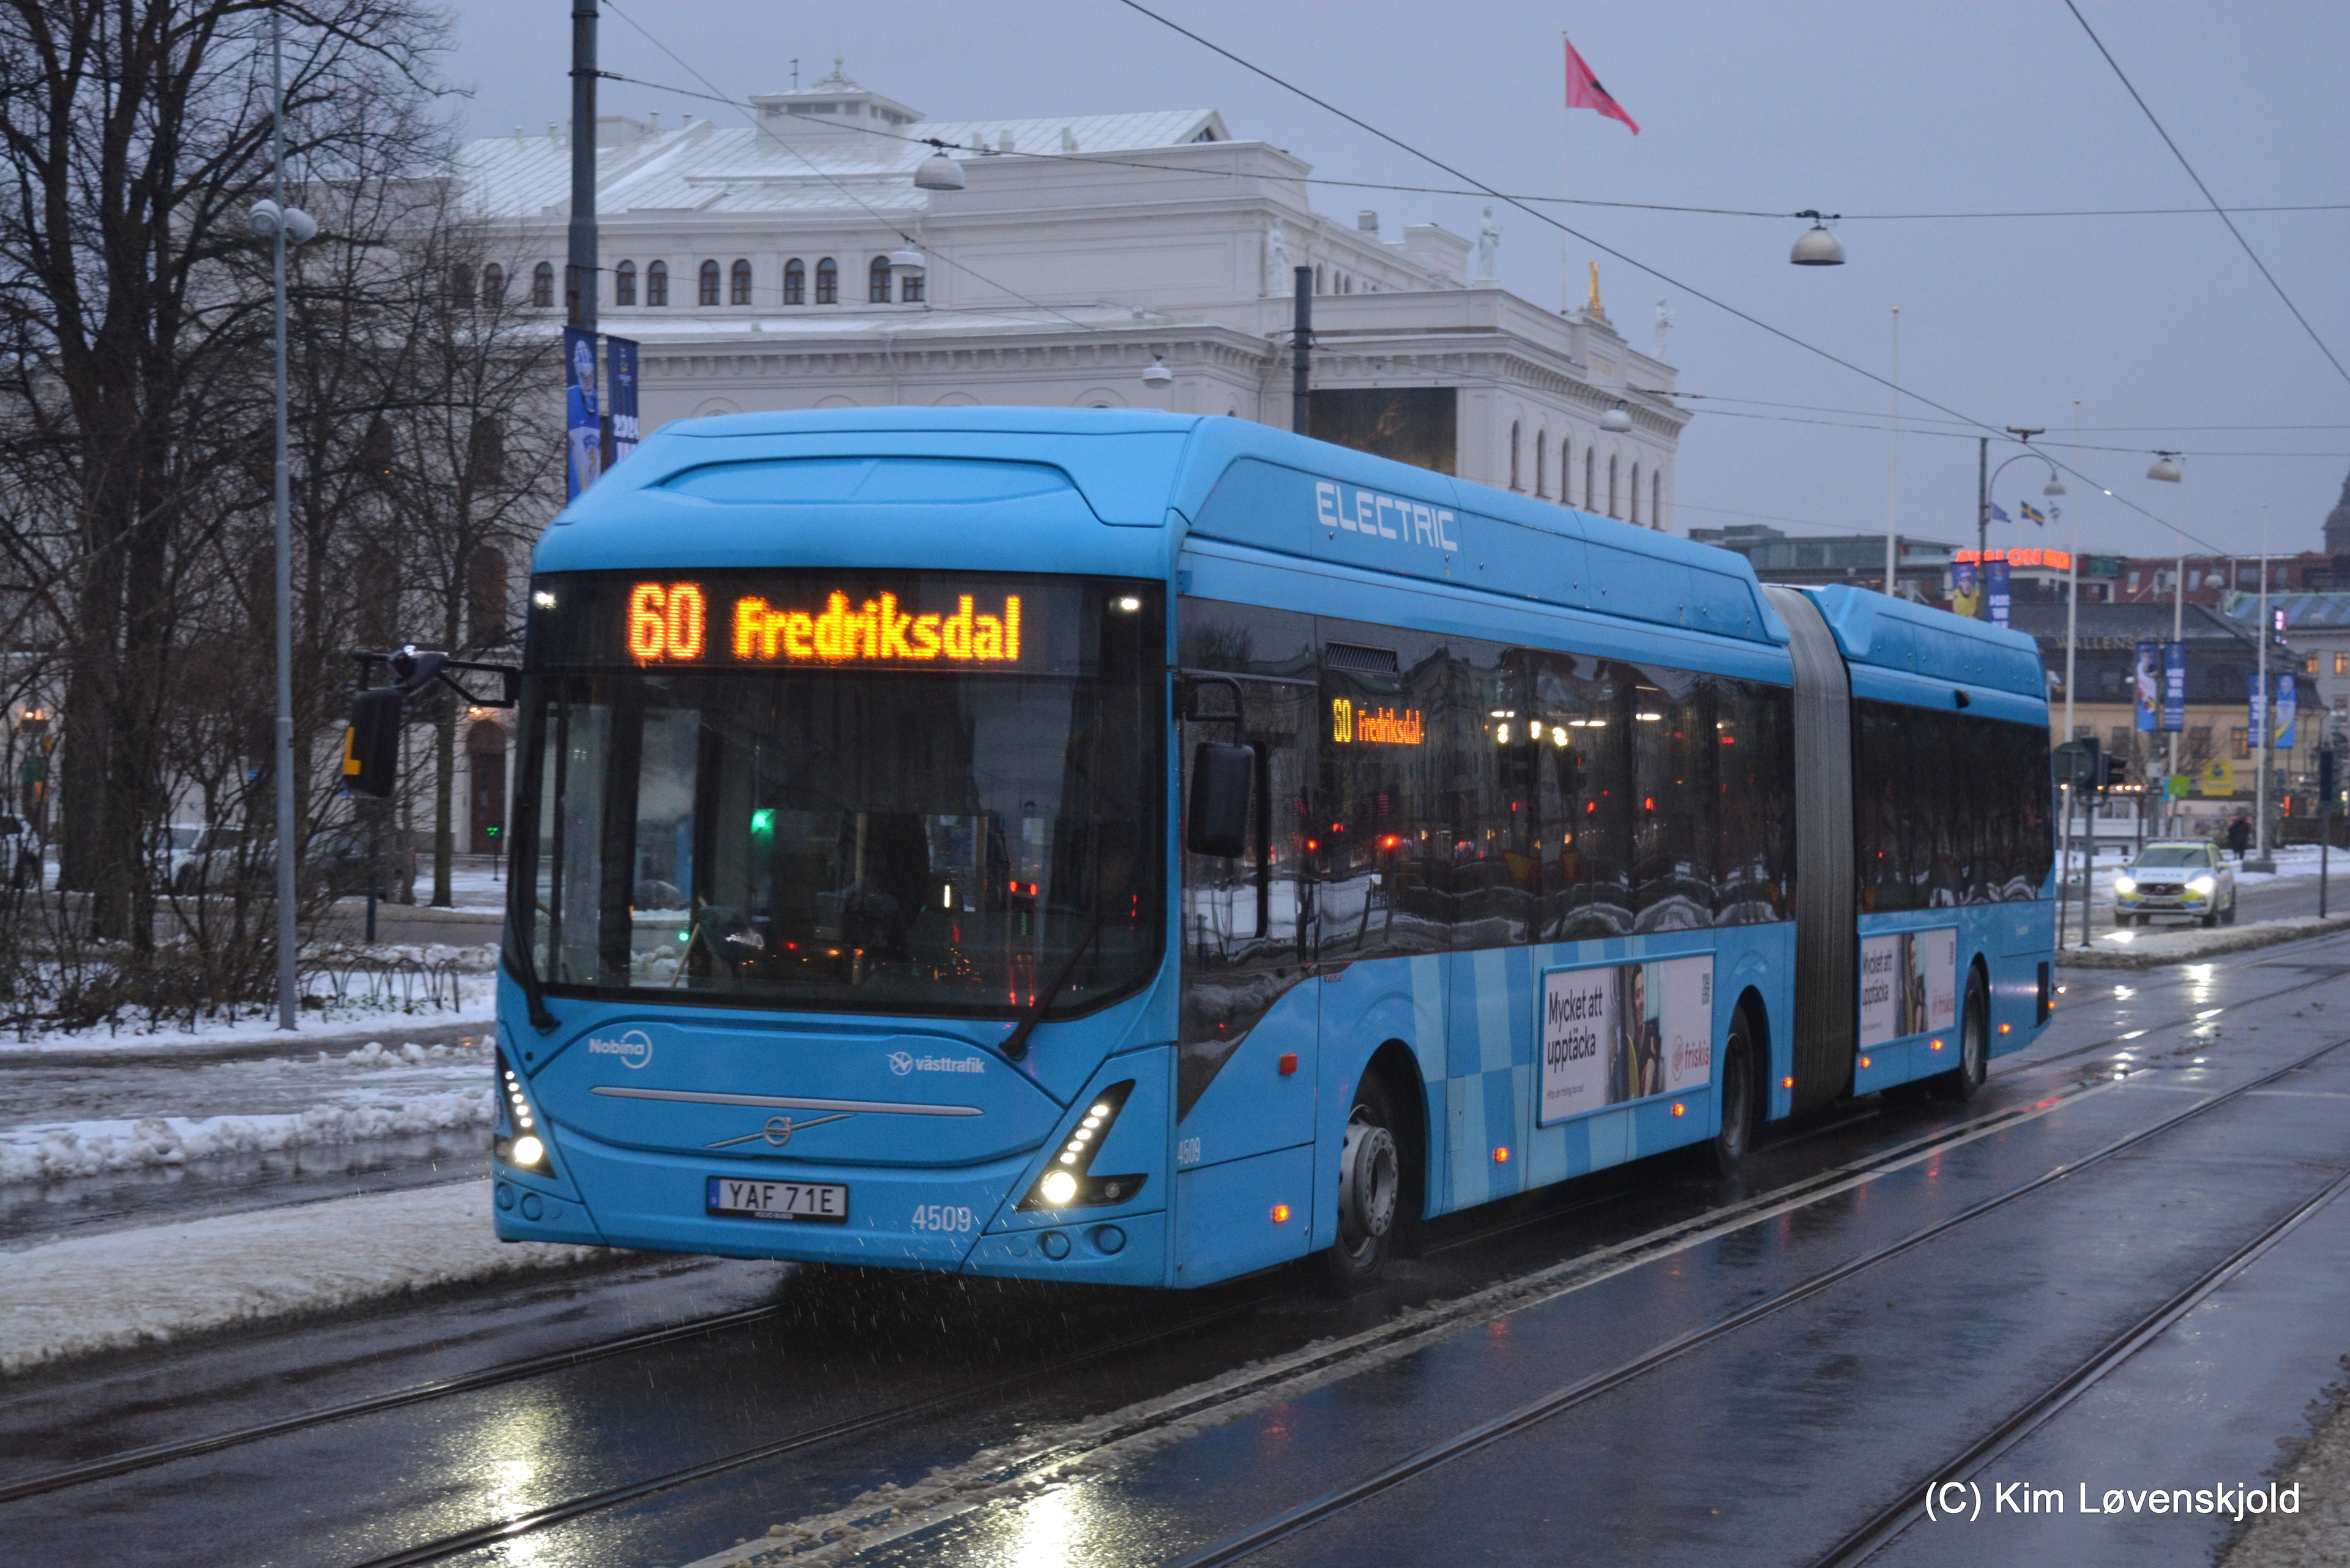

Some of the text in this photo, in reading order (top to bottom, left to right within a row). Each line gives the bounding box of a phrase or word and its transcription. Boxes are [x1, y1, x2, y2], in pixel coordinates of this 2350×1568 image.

[1316, 481, 1458, 552] ELECTRIC
[630, 583, 1021, 662] 60 Fredriksdal
[1334, 699, 1420, 744] 60 Fredriksdal
[1549, 985, 1603, 1032] Mycket att
[589, 1038, 644, 1055] Nobina
[1547, 1026, 1596, 1073] upptäcka
[1685, 1039, 1709, 1070] friskis
[915, 1055, 985, 1073] västtrafik
[1177, 1137, 1201, 1165] 4509
[729, 1183, 834, 1214] YAF 71E
[911, 1204, 972, 1232] 4509
